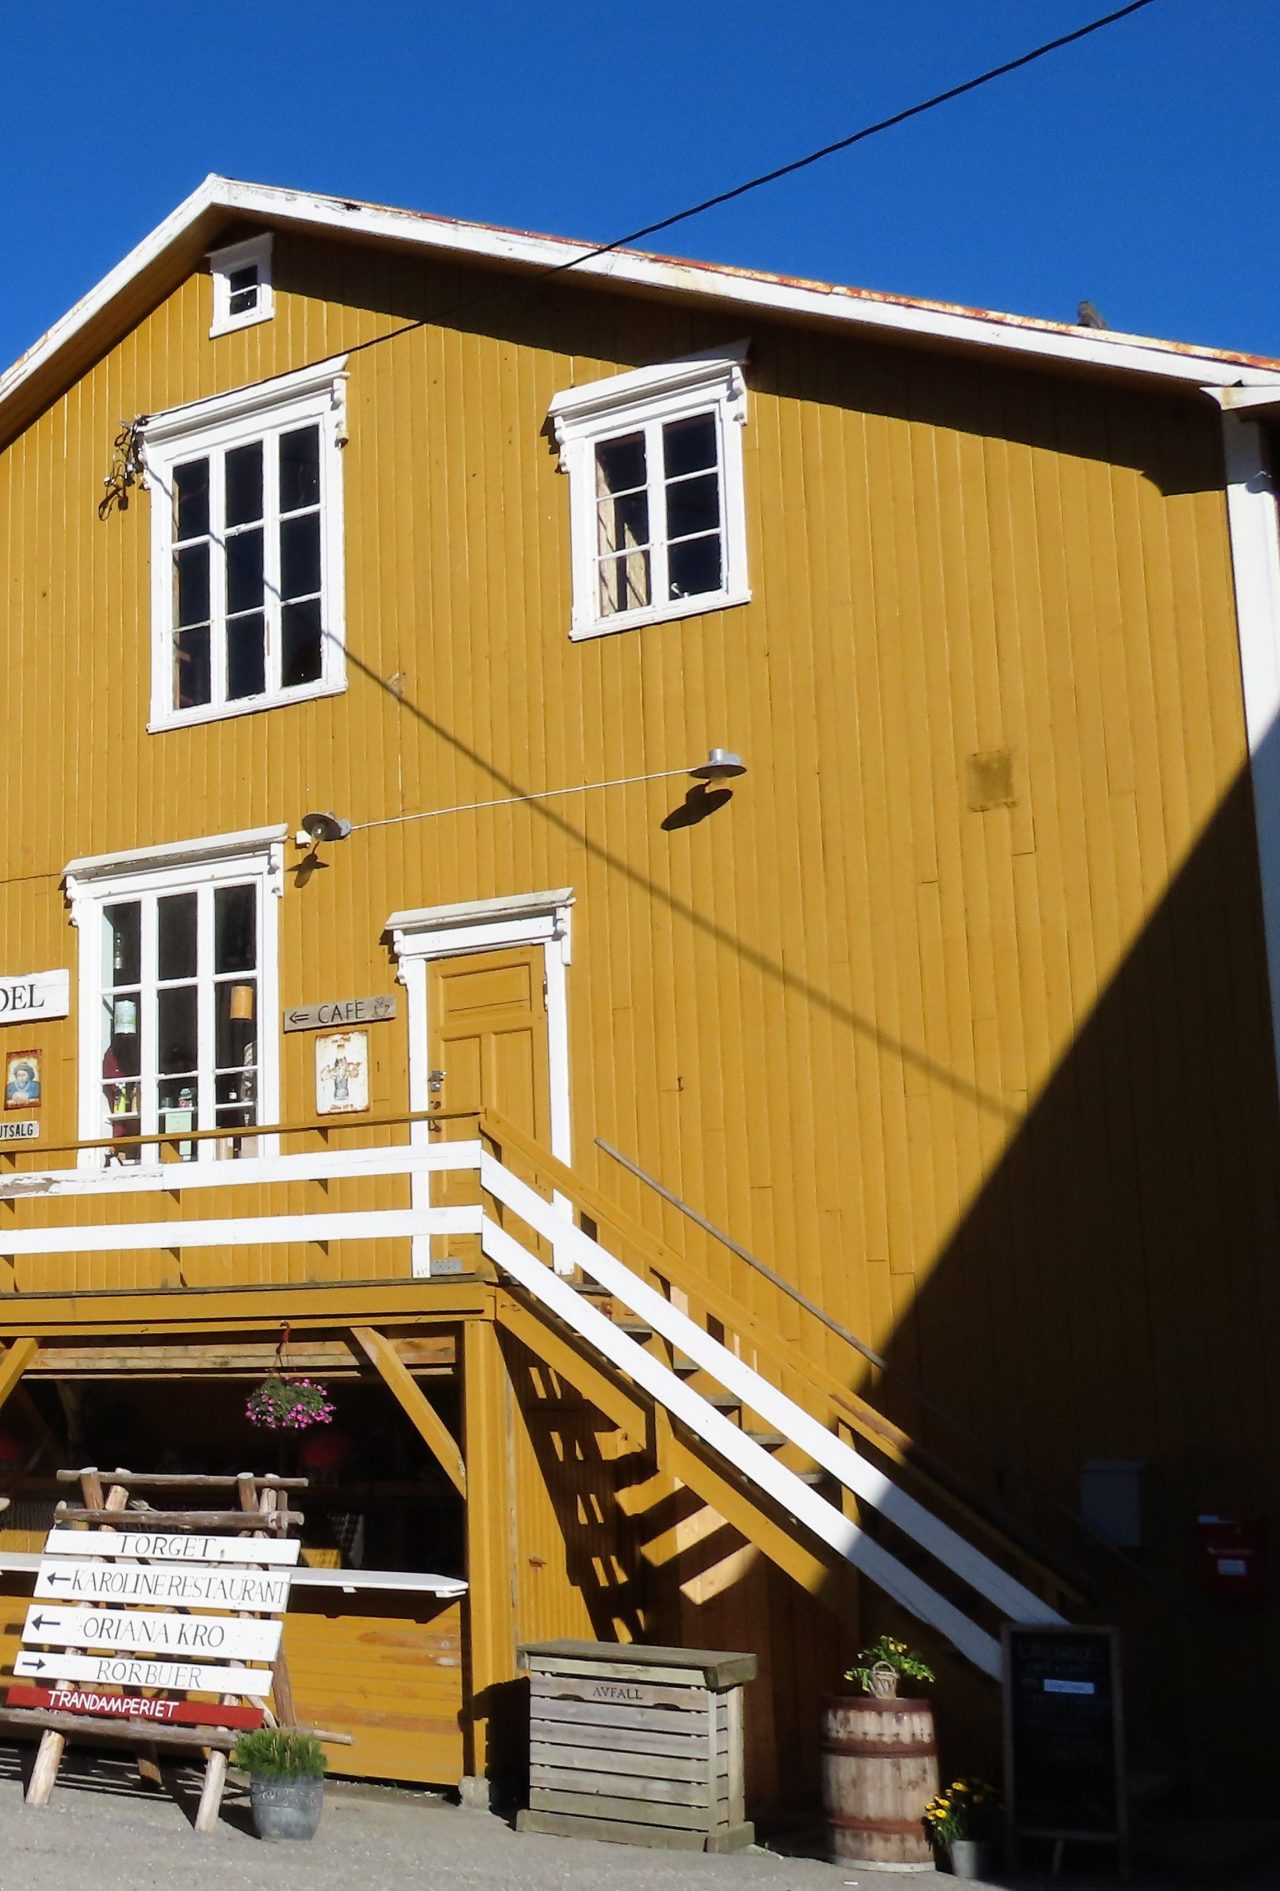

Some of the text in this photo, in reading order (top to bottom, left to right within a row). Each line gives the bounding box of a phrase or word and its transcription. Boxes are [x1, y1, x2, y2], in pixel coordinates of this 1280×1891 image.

[117, 1534, 216, 1558] TORGET
[83, 1617, 225, 1648] ORIANA KRO
[96, 1660, 202, 1689] RORBUER
[47, 1690, 180, 1718] TRANDAMPERIET
[592, 1686, 643, 1700] AVFALL
